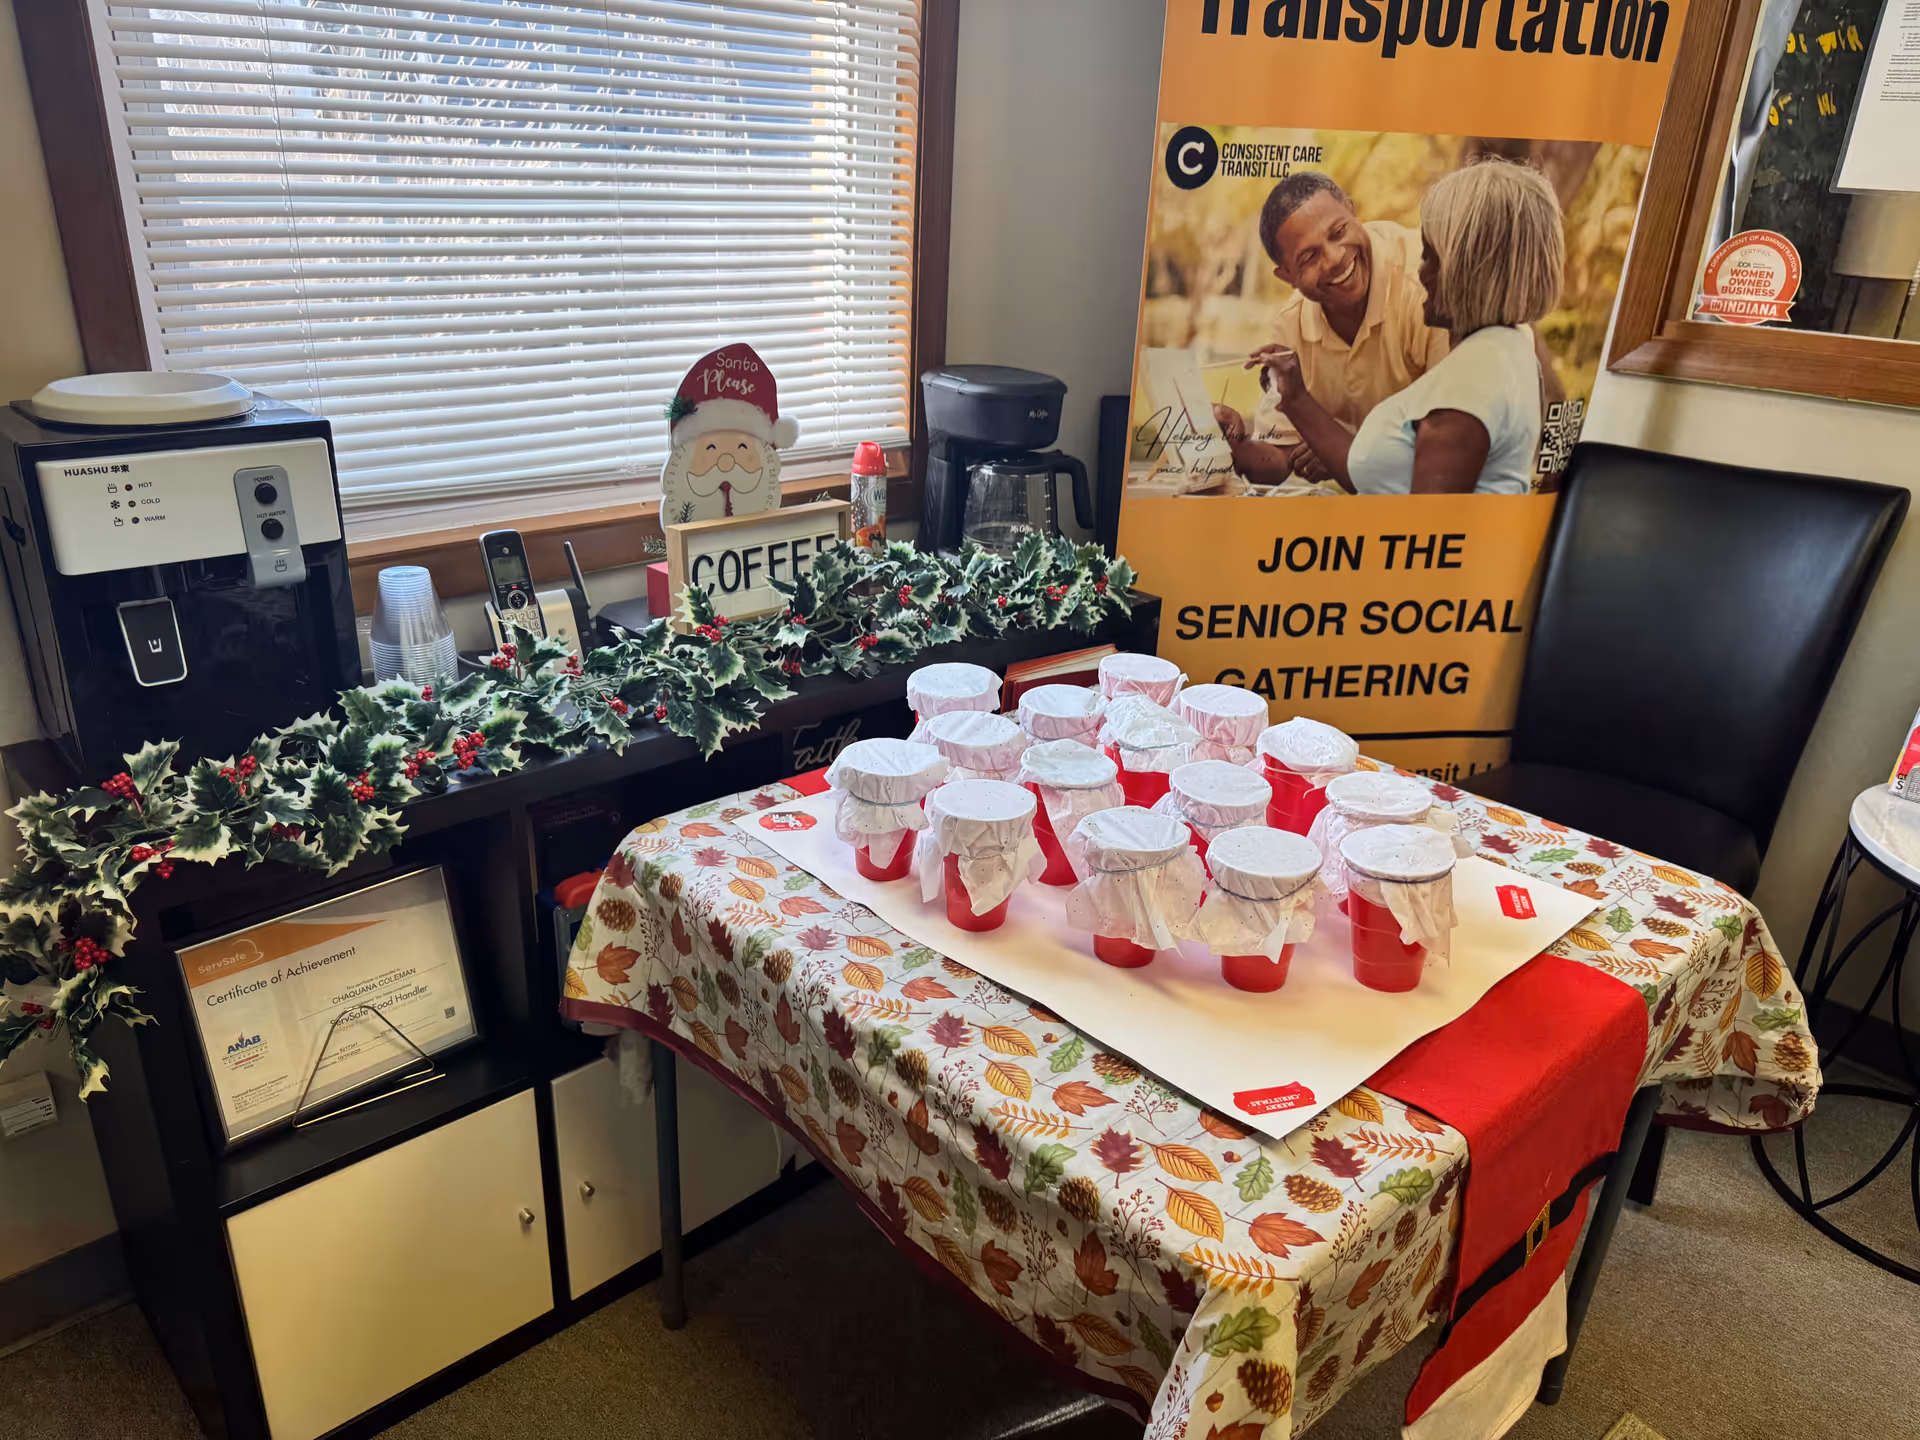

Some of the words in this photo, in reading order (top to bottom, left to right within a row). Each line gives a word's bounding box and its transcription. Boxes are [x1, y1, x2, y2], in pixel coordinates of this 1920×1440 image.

[1177, 141, 1205, 175] C
[1221, 143, 1290, 162] CONSISTENT
[1292, 146, 1323, 163] CARE
[1221, 160, 1268, 177] TRANSIT
[1270, 162, 1290, 178] LLC
[1711, 237, 1748, 268] DEPARTMENT
[1760, 235, 1798, 273] ADMINISTRATION
[1728, 278, 1771, 288] OWNED
[1730, 269, 1774, 279] WOMEN
[1720, 286, 1776, 297] BUSINESS
[1722, 301, 1777, 316] INDIANA
[716, 352, 759, 372] Santa
[697, 368, 756, 395] Please
[1135, 406, 1214, 460] Helping
[1258, 424, 1283, 441] who
[64, 466, 109, 477] HUASHU
[253, 474, 275, 482] POWER
[1156, 466, 1184, 475] once
[1190, 457, 1235, 484] helped
[1258, 535, 1365, 573] JOIN
[1379, 533, 1466, 570] THE
[1176, 602, 1347, 640] SENIOR
[1360, 599, 1523, 635] SOCIAL
[198, 952, 246, 974] ServSafe
[206, 978, 268, 1007] Certificate
[270, 970, 283, 985] of
[286, 946, 356, 979] Achievement
[332, 983, 378, 1005] CHAQUANA
[379, 968, 417, 987] COLEMAN
[330, 1008, 369, 1027] ServSafe
[372, 995, 394, 1011] Food
[395, 984, 428, 1003] Handler
[227, 1035, 262, 1055] ANAB
[1249, 1093, 1300, 1107] CHRISTMAS
[1266, 1101, 1295, 1111] MERRY
